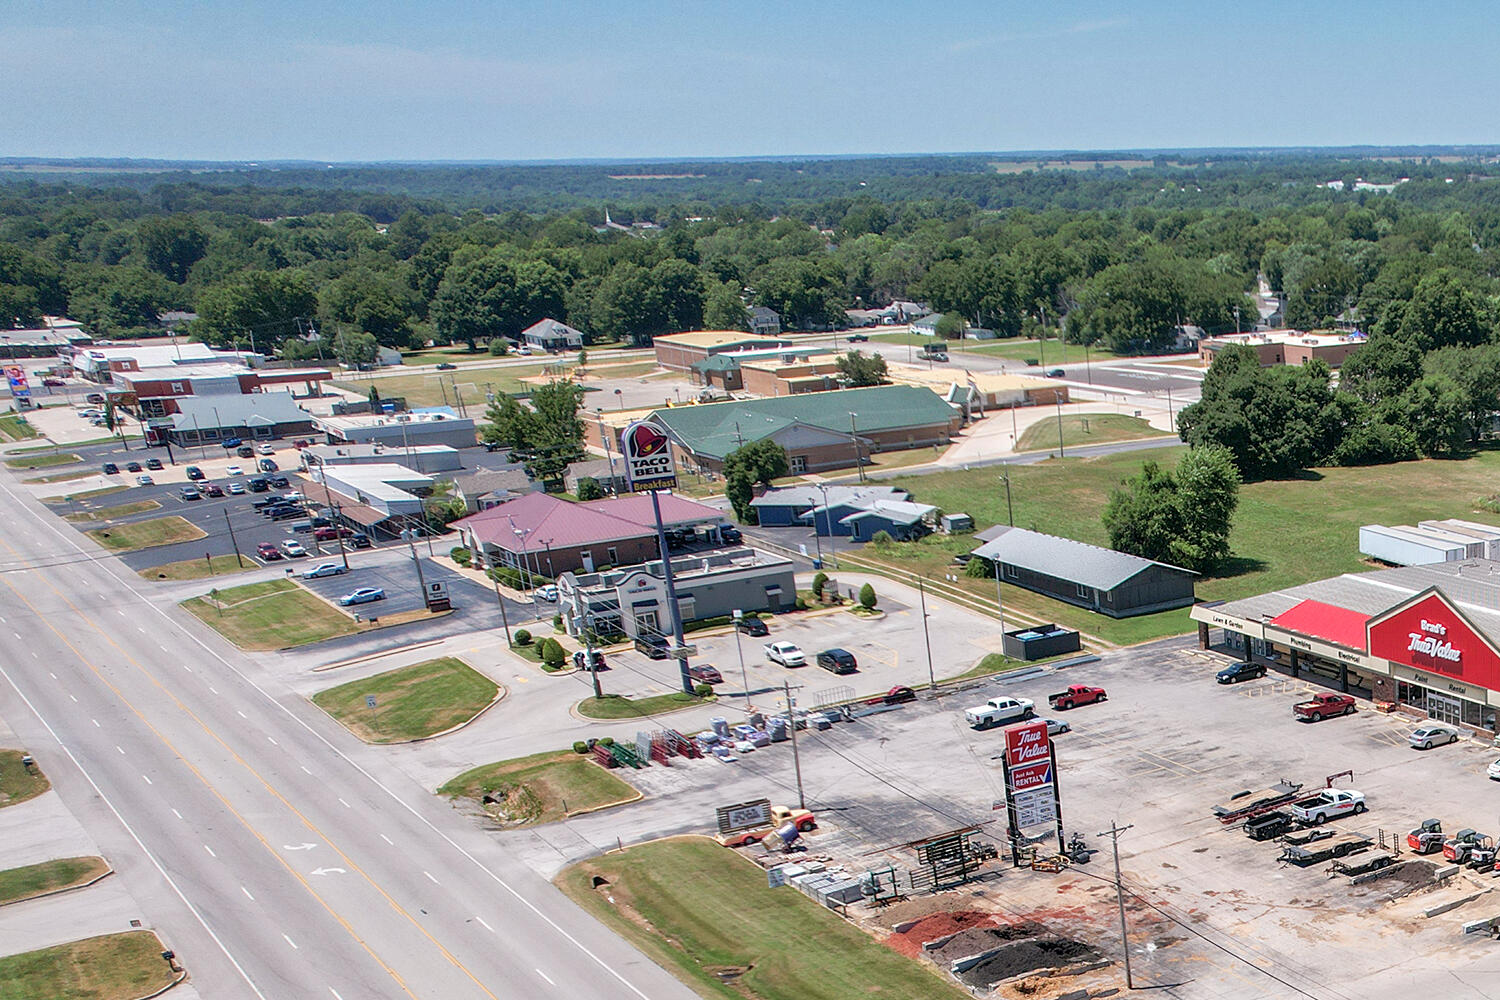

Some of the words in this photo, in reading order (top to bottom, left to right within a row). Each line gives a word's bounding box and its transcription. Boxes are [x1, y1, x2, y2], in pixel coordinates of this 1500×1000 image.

[630, 457, 670, 468] TACO
[634, 465, 672, 477] BELL
[633, 479, 675, 491] Breakfast
[1420, 619, 1447, 635] Brad's
[1290, 637, 1312, 650] Plumbing
[1449, 683, 1466, 694] Rental
[1018, 730, 1042, 746] True
[1012, 742, 1048, 761] Value
[1015, 776, 1041, 787] RENTAL
